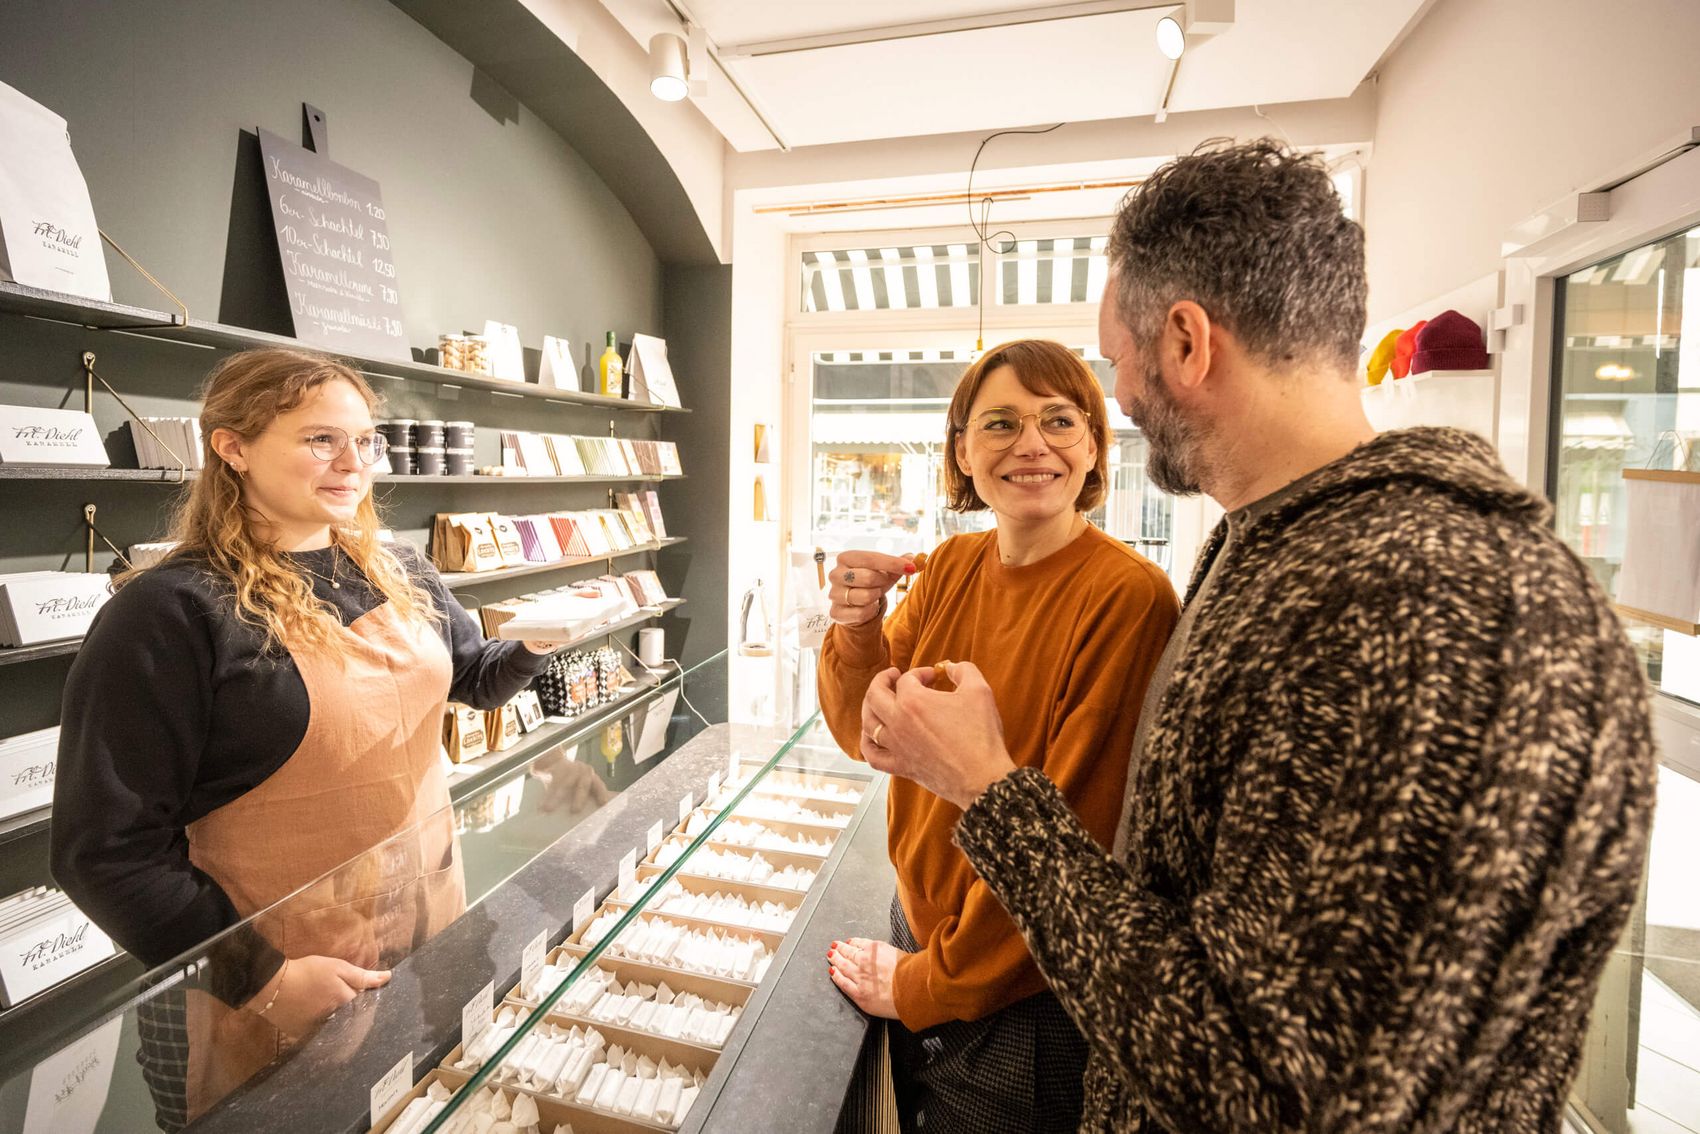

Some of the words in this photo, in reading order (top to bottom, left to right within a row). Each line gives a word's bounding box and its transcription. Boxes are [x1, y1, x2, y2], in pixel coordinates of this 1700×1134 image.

[270, 156, 361, 212] Karamellbonbon
[308, 207, 364, 240] Schachtel
[56, 228, 82, 249] Diehl
[12, 425, 45, 439] Frl.
[45, 427, 82, 441] Diehl
[35, 597, 66, 615] Frl.
[65, 593, 101, 612] Diehl
[19, 939, 53, 967] Frl.
[51, 922, 89, 953] Diehl
